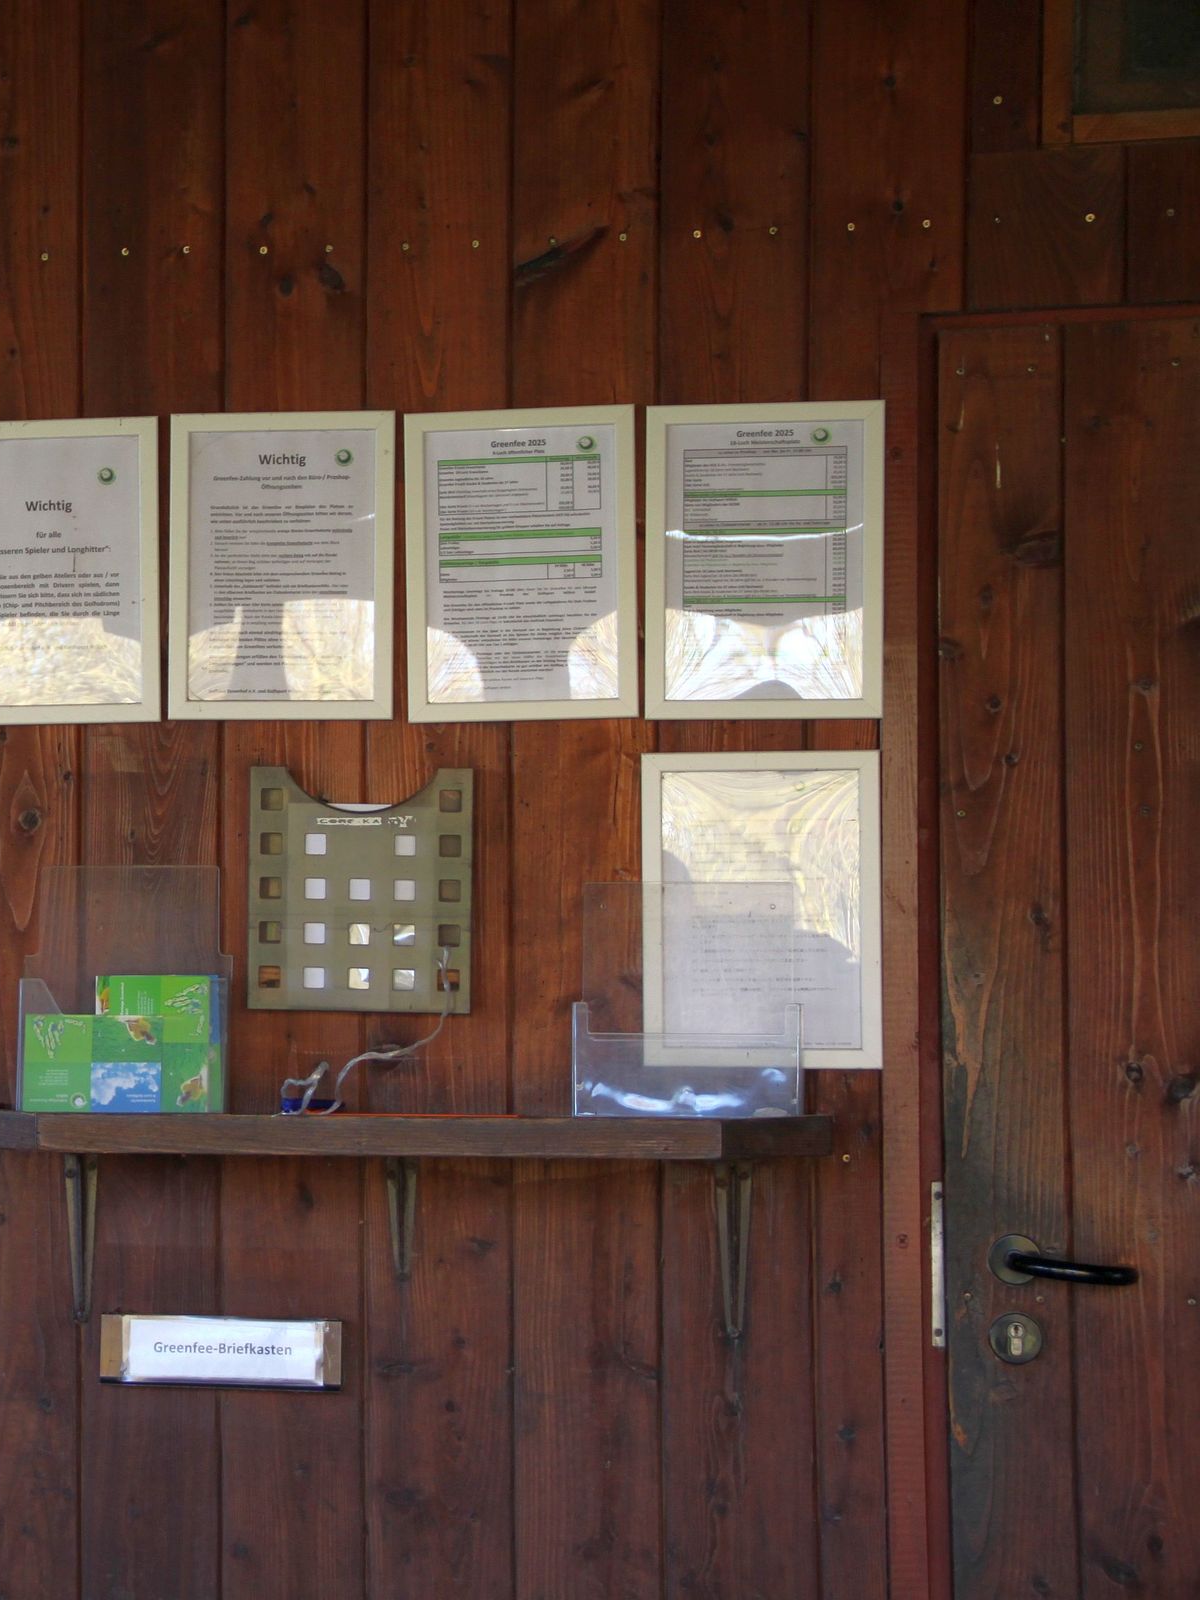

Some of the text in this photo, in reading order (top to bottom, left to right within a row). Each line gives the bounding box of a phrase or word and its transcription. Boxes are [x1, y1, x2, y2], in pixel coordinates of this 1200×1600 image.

[736, 429, 795, 438] Greenfee 2025
[490, 439, 547, 448] Greenfee 2025
[258, 453, 307, 467] Wichtig
[25, 500, 73, 513] Wichtig
[25, 547, 50, 555] Spieler
[153, 1341, 293, 1357] Greenfee-Briefkasten
